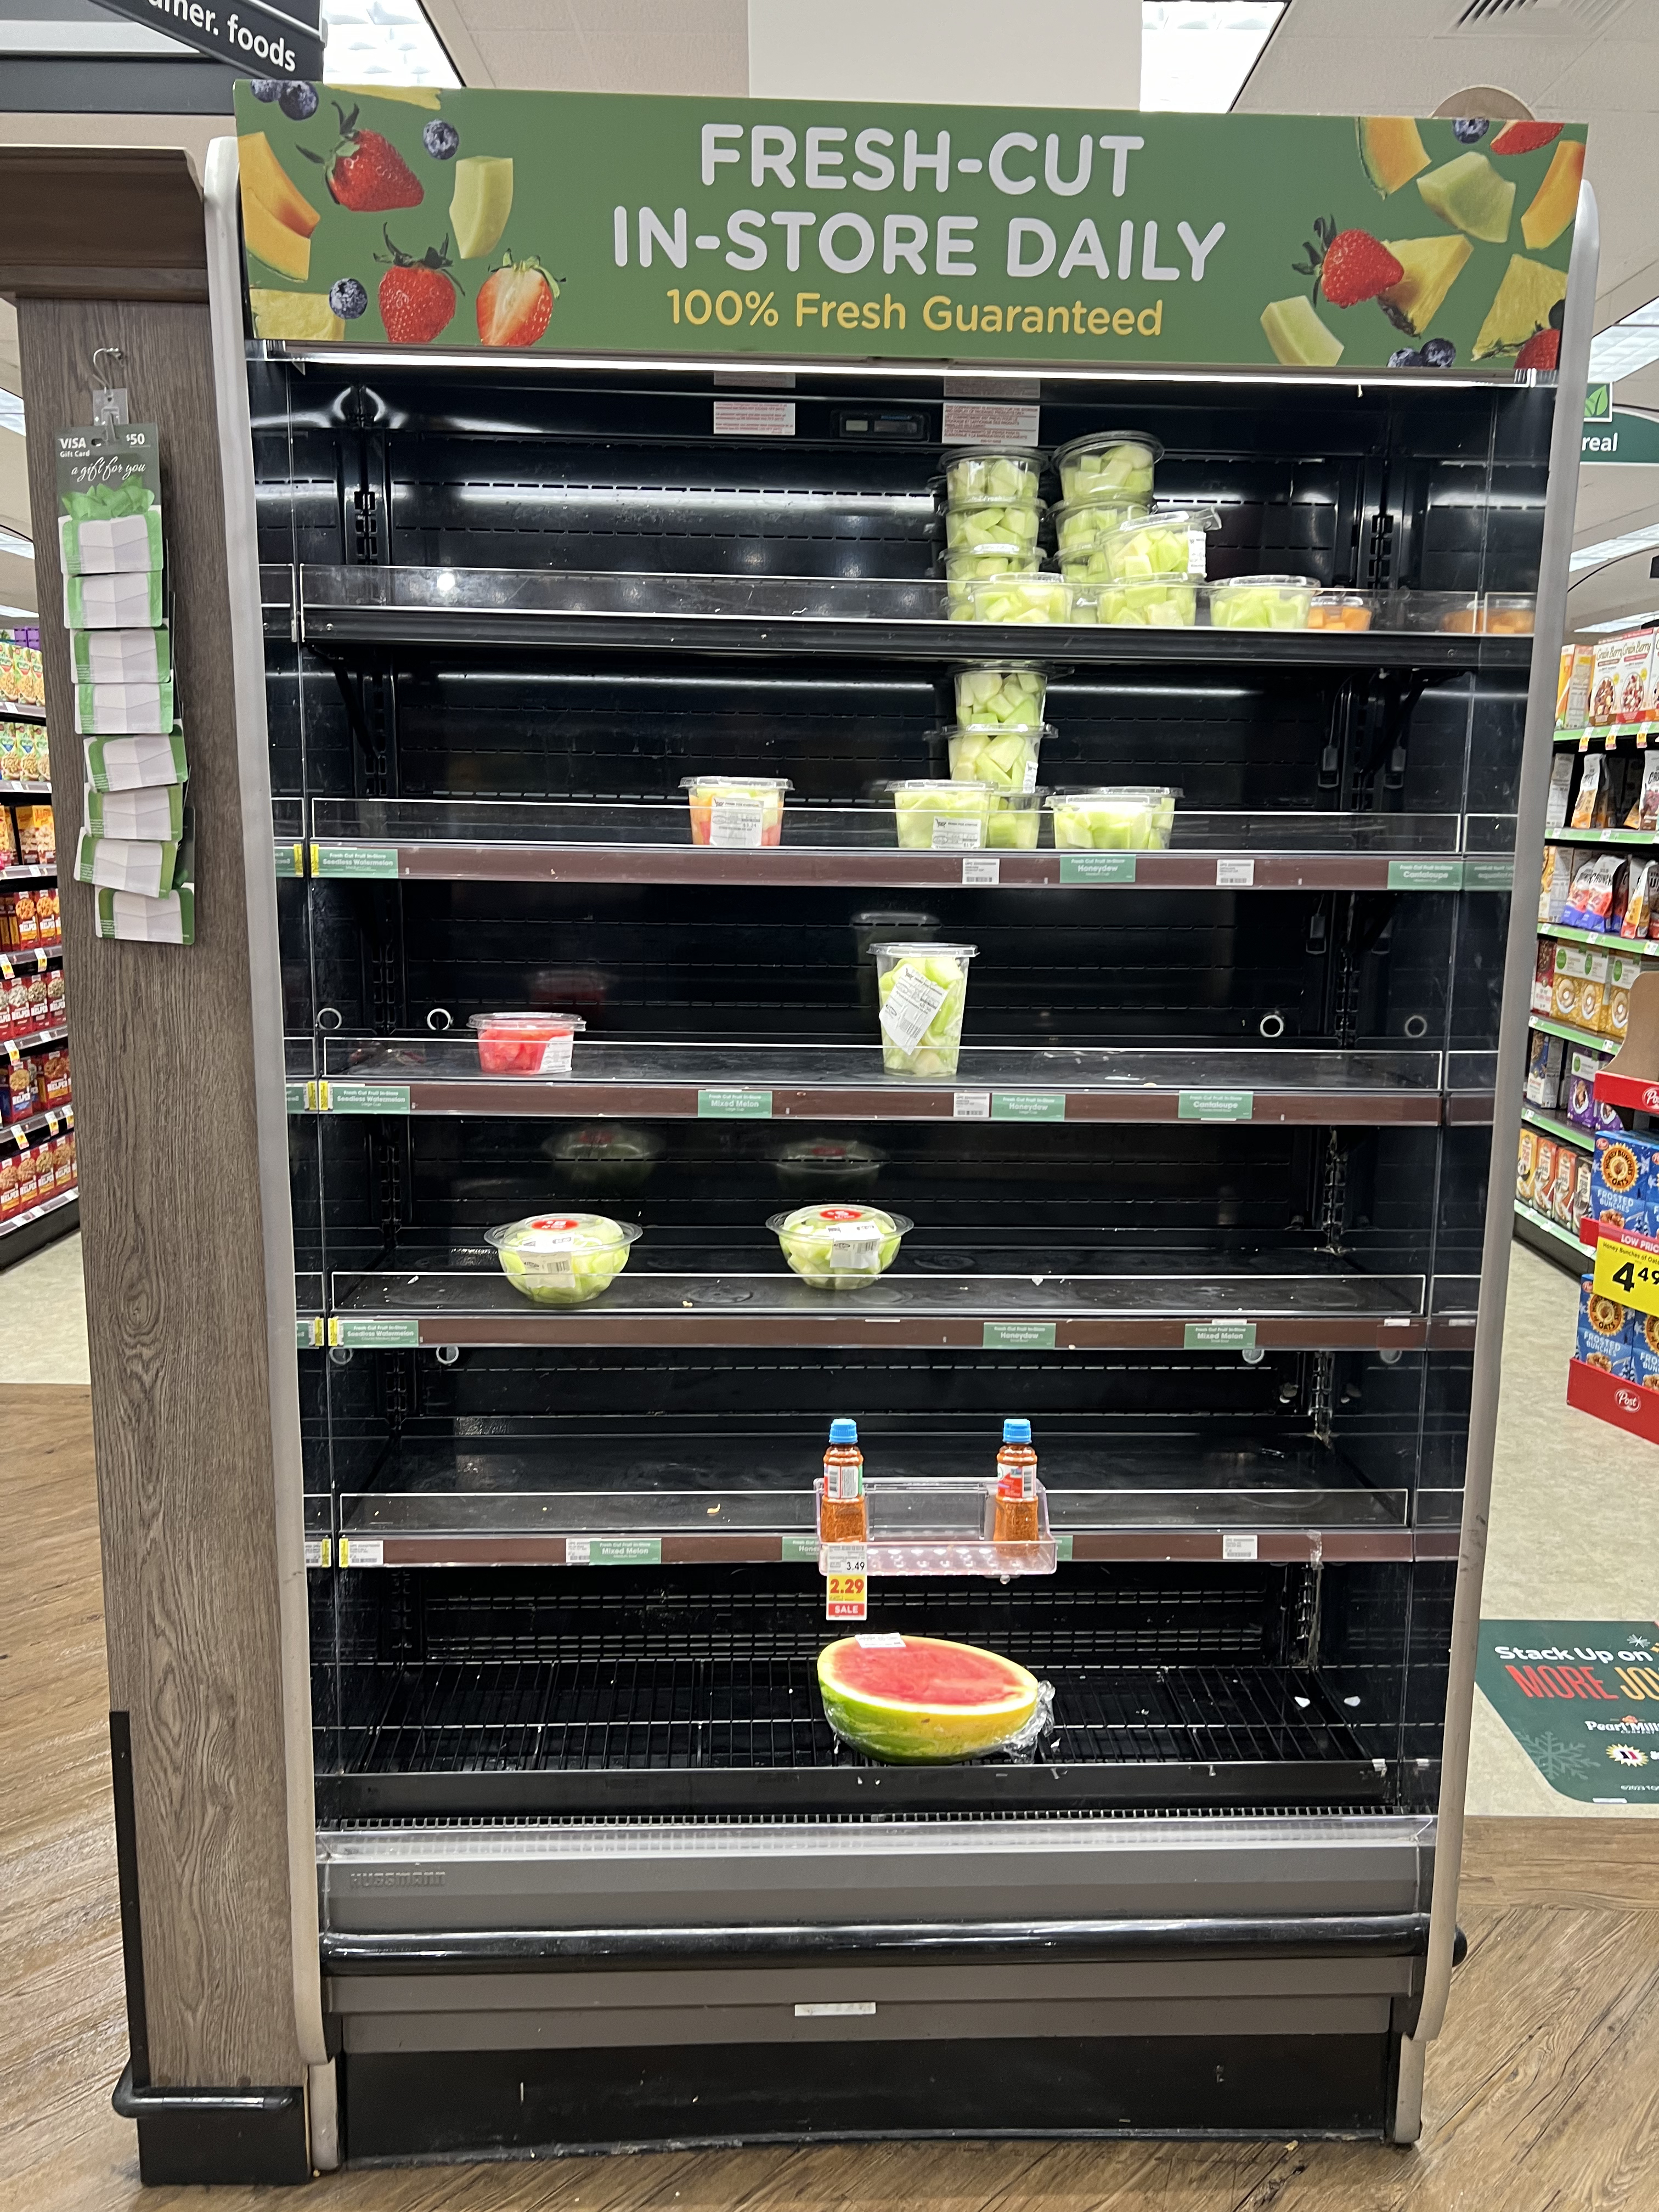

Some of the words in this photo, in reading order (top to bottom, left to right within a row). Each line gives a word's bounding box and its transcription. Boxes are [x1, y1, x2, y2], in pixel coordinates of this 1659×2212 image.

[227, 13, 296, 72] foods
[701, 123, 1144, 197] FRESH-CUT
[613, 205, 978, 276] IN-STORE
[1006, 217, 1225, 282] DAILY
[666, 288, 779, 326] 100%
[795, 292, 906, 330] Fresh
[922, 294, 1163, 336] Guaranteed
[59, 437, 86, 449] VISA
[1582, 432, 1618, 452] real
[77, 456, 105, 482] gift
[102, 456, 123, 481] for
[122, 464, 146, 480] you
[1009, 1103, 1048, 1111] Honeydew
[1193, 1101, 1238, 1109] Cantaloupe
[1612, 1177, 1629, 1186] OATS
[1598, 1189, 1634, 1207] FROSTED
[1600, 1198, 1630, 1213] BUNCHES
[1621, 1234, 1639, 1247] LOW
[1603, 1242, 1618, 1252] Honey
[1620, 1248, 1640, 1259] Bunches
[1599, 1322, 1615, 1330] OATS
[1584, 1330, 1621, 1352] FROSTED
[1640, 1352, 1659, 1364] FRO
[1618, 1391, 1638, 1406] Post
[847, 1562, 865, 1571] 3.49
[830, 1578, 864, 1594] 2.29
[834, 1605, 858, 1614] SALE
[1494, 1646, 1575, 1660] Stack
[1573, 1647, 1614, 1664] Up
[1617, 1650, 1653, 1661] on
[1505, 1665, 1619, 1699] MORE
[1584, 1720, 1627, 1731] Pearl
